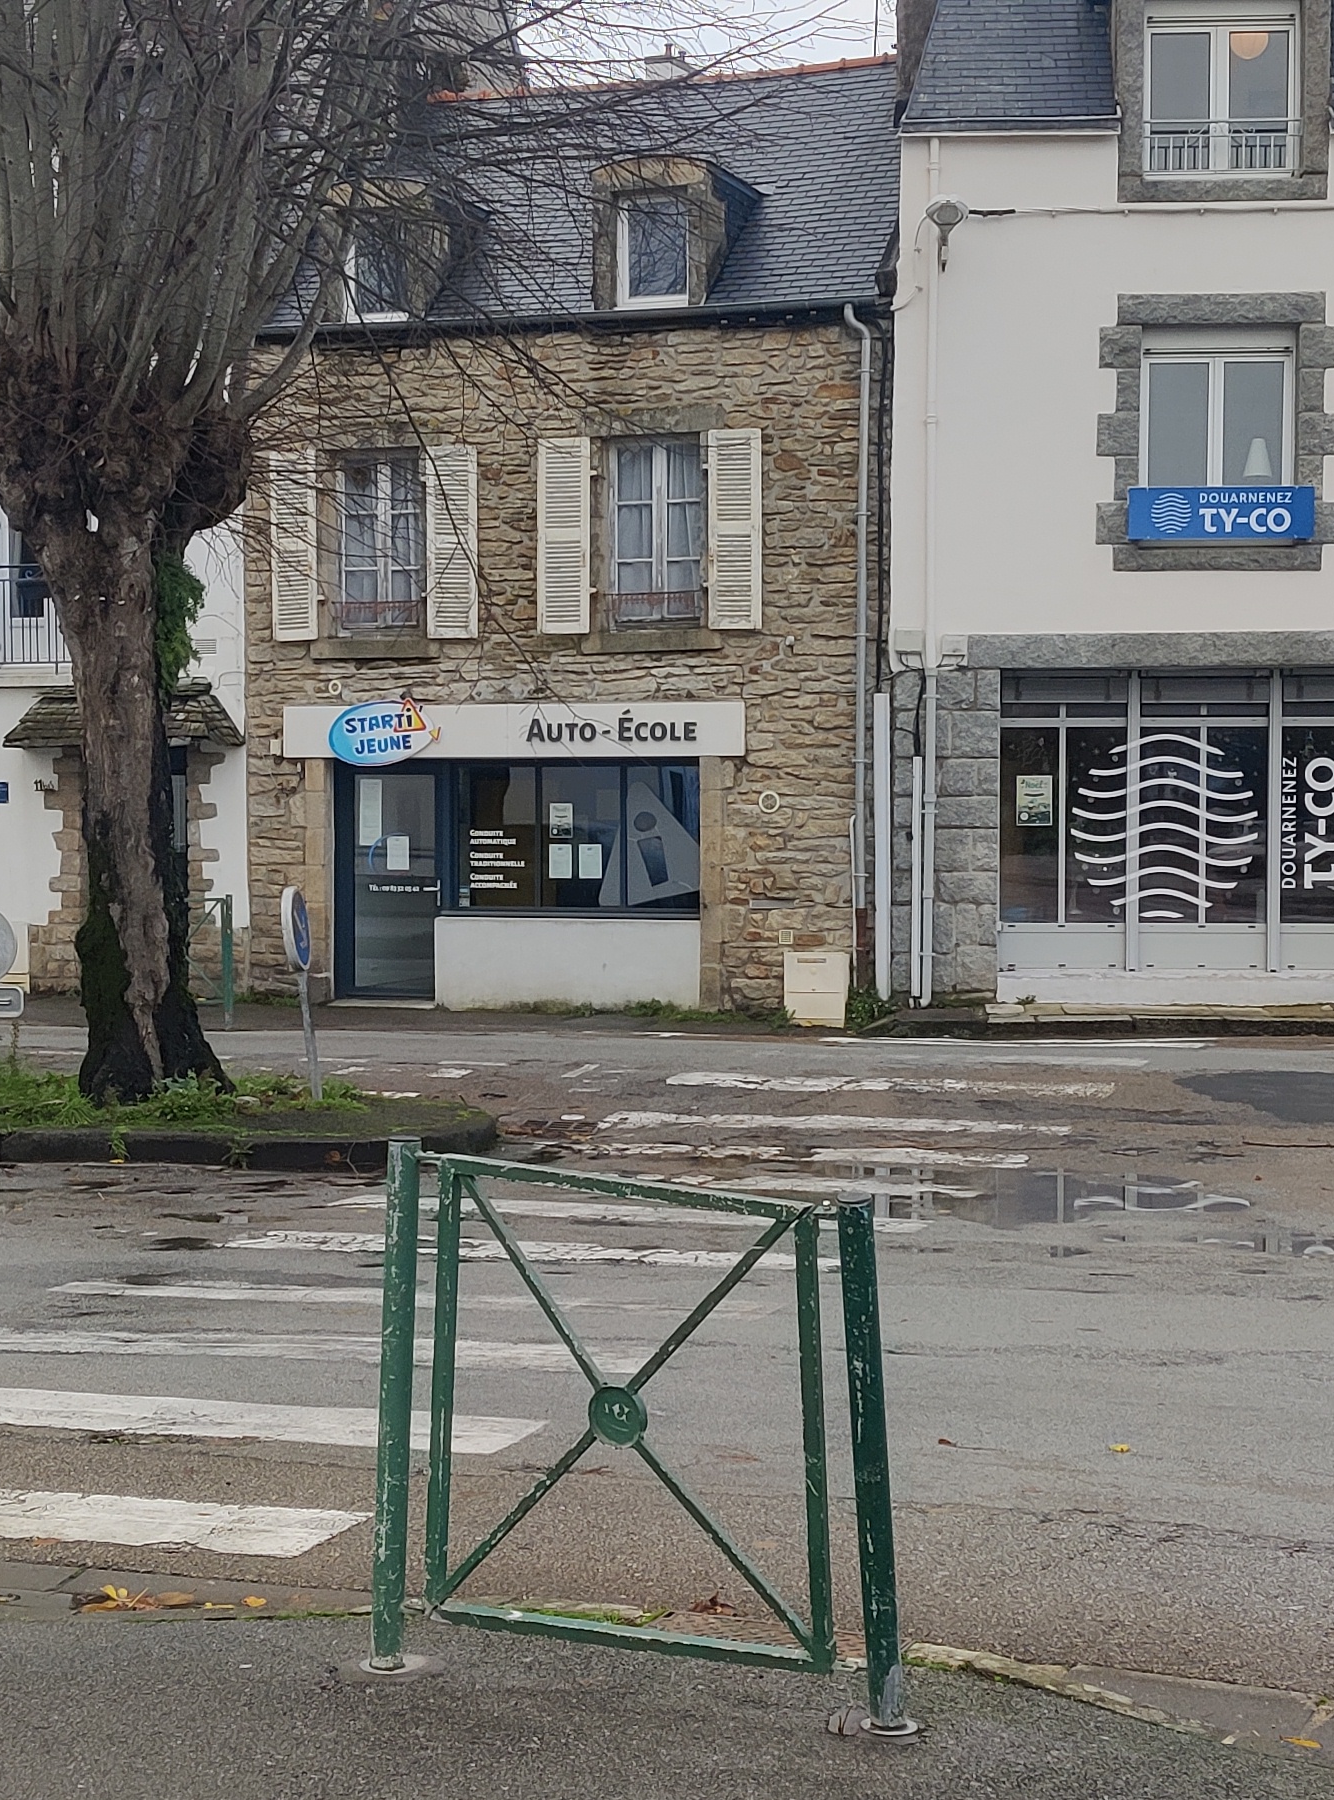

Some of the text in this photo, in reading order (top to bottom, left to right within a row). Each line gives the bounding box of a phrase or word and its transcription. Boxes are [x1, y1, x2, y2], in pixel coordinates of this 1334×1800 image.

[1199, 492, 1292, 504] DOUARNENEZ
[1198, 507, 1292, 533] TY-CO
[354, 734, 412, 755] JEUNE
[1281, 756, 1297, 889] DOUARNENEZ
